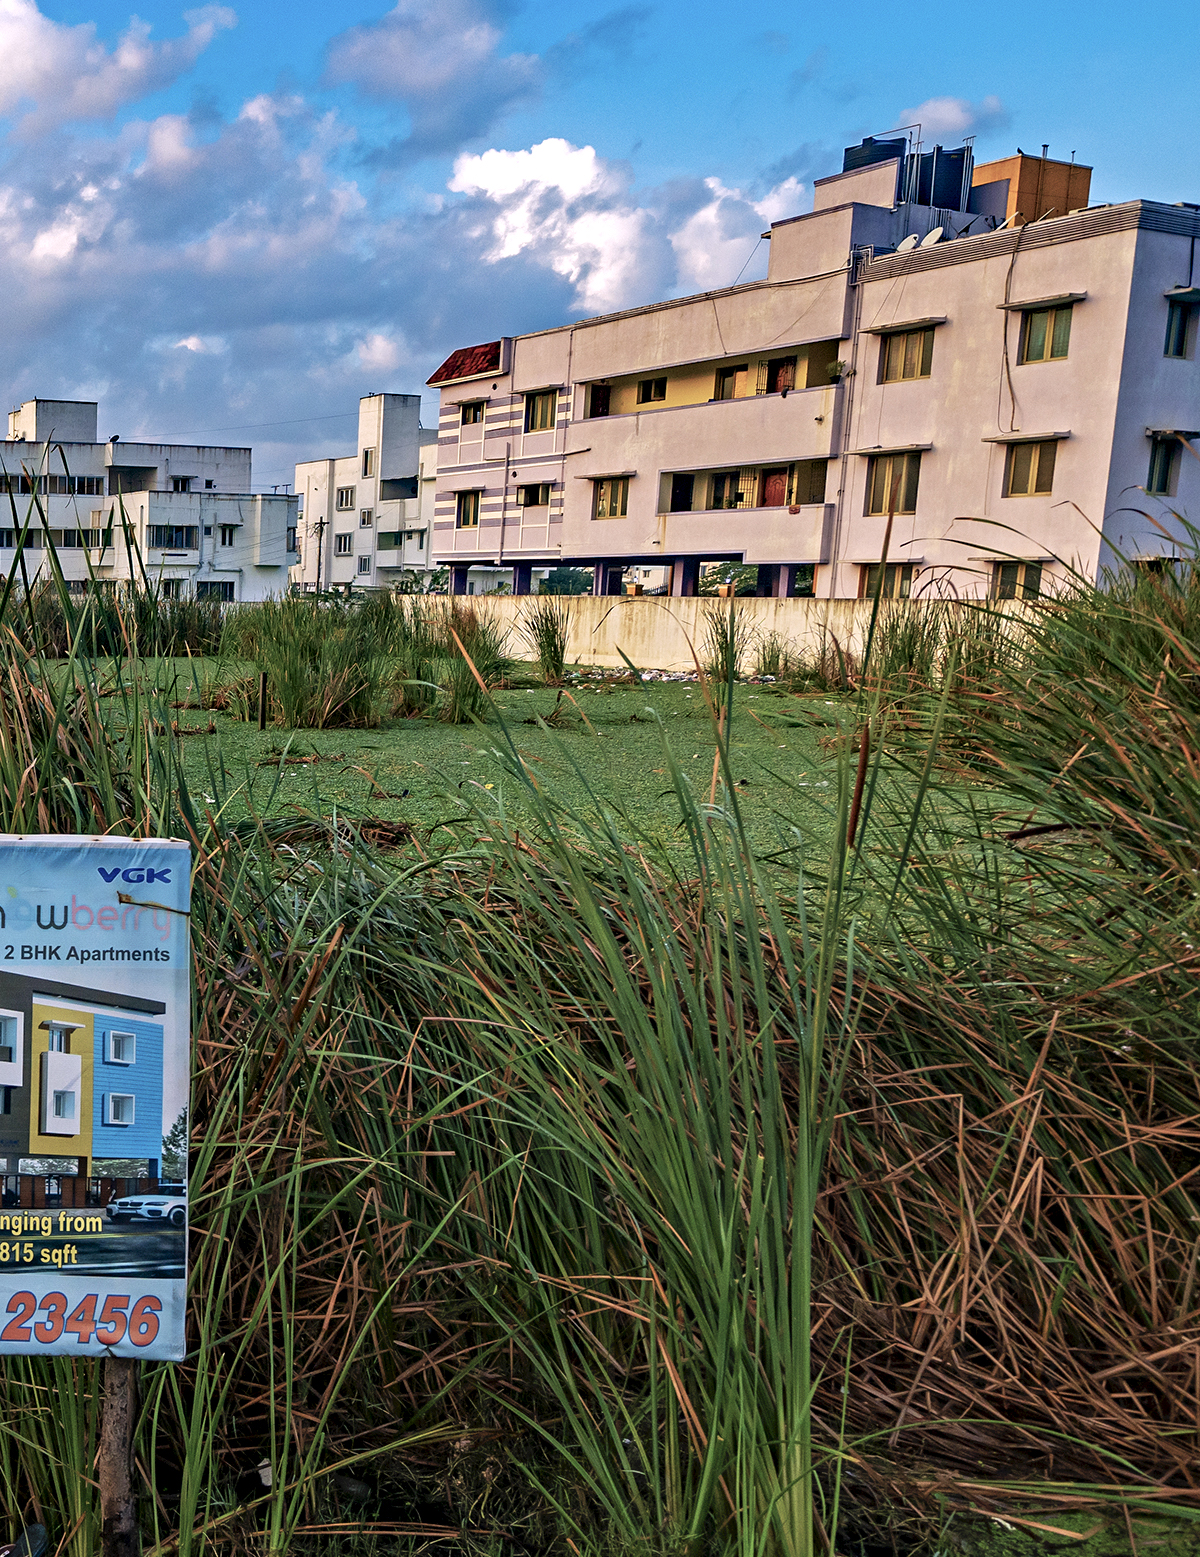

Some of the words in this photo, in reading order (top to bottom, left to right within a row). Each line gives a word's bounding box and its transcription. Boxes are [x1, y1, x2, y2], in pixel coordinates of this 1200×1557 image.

[98, 867, 172, 884] VGK
[4, 945, 14, 960] 2
[21, 945, 62, 960] BHK
[66, 946, 170, 964] Apartments
[58, 1211, 103, 1233] from
[40, 1244, 78, 1268] sqft
[0, 1290, 162, 1347] 23456
